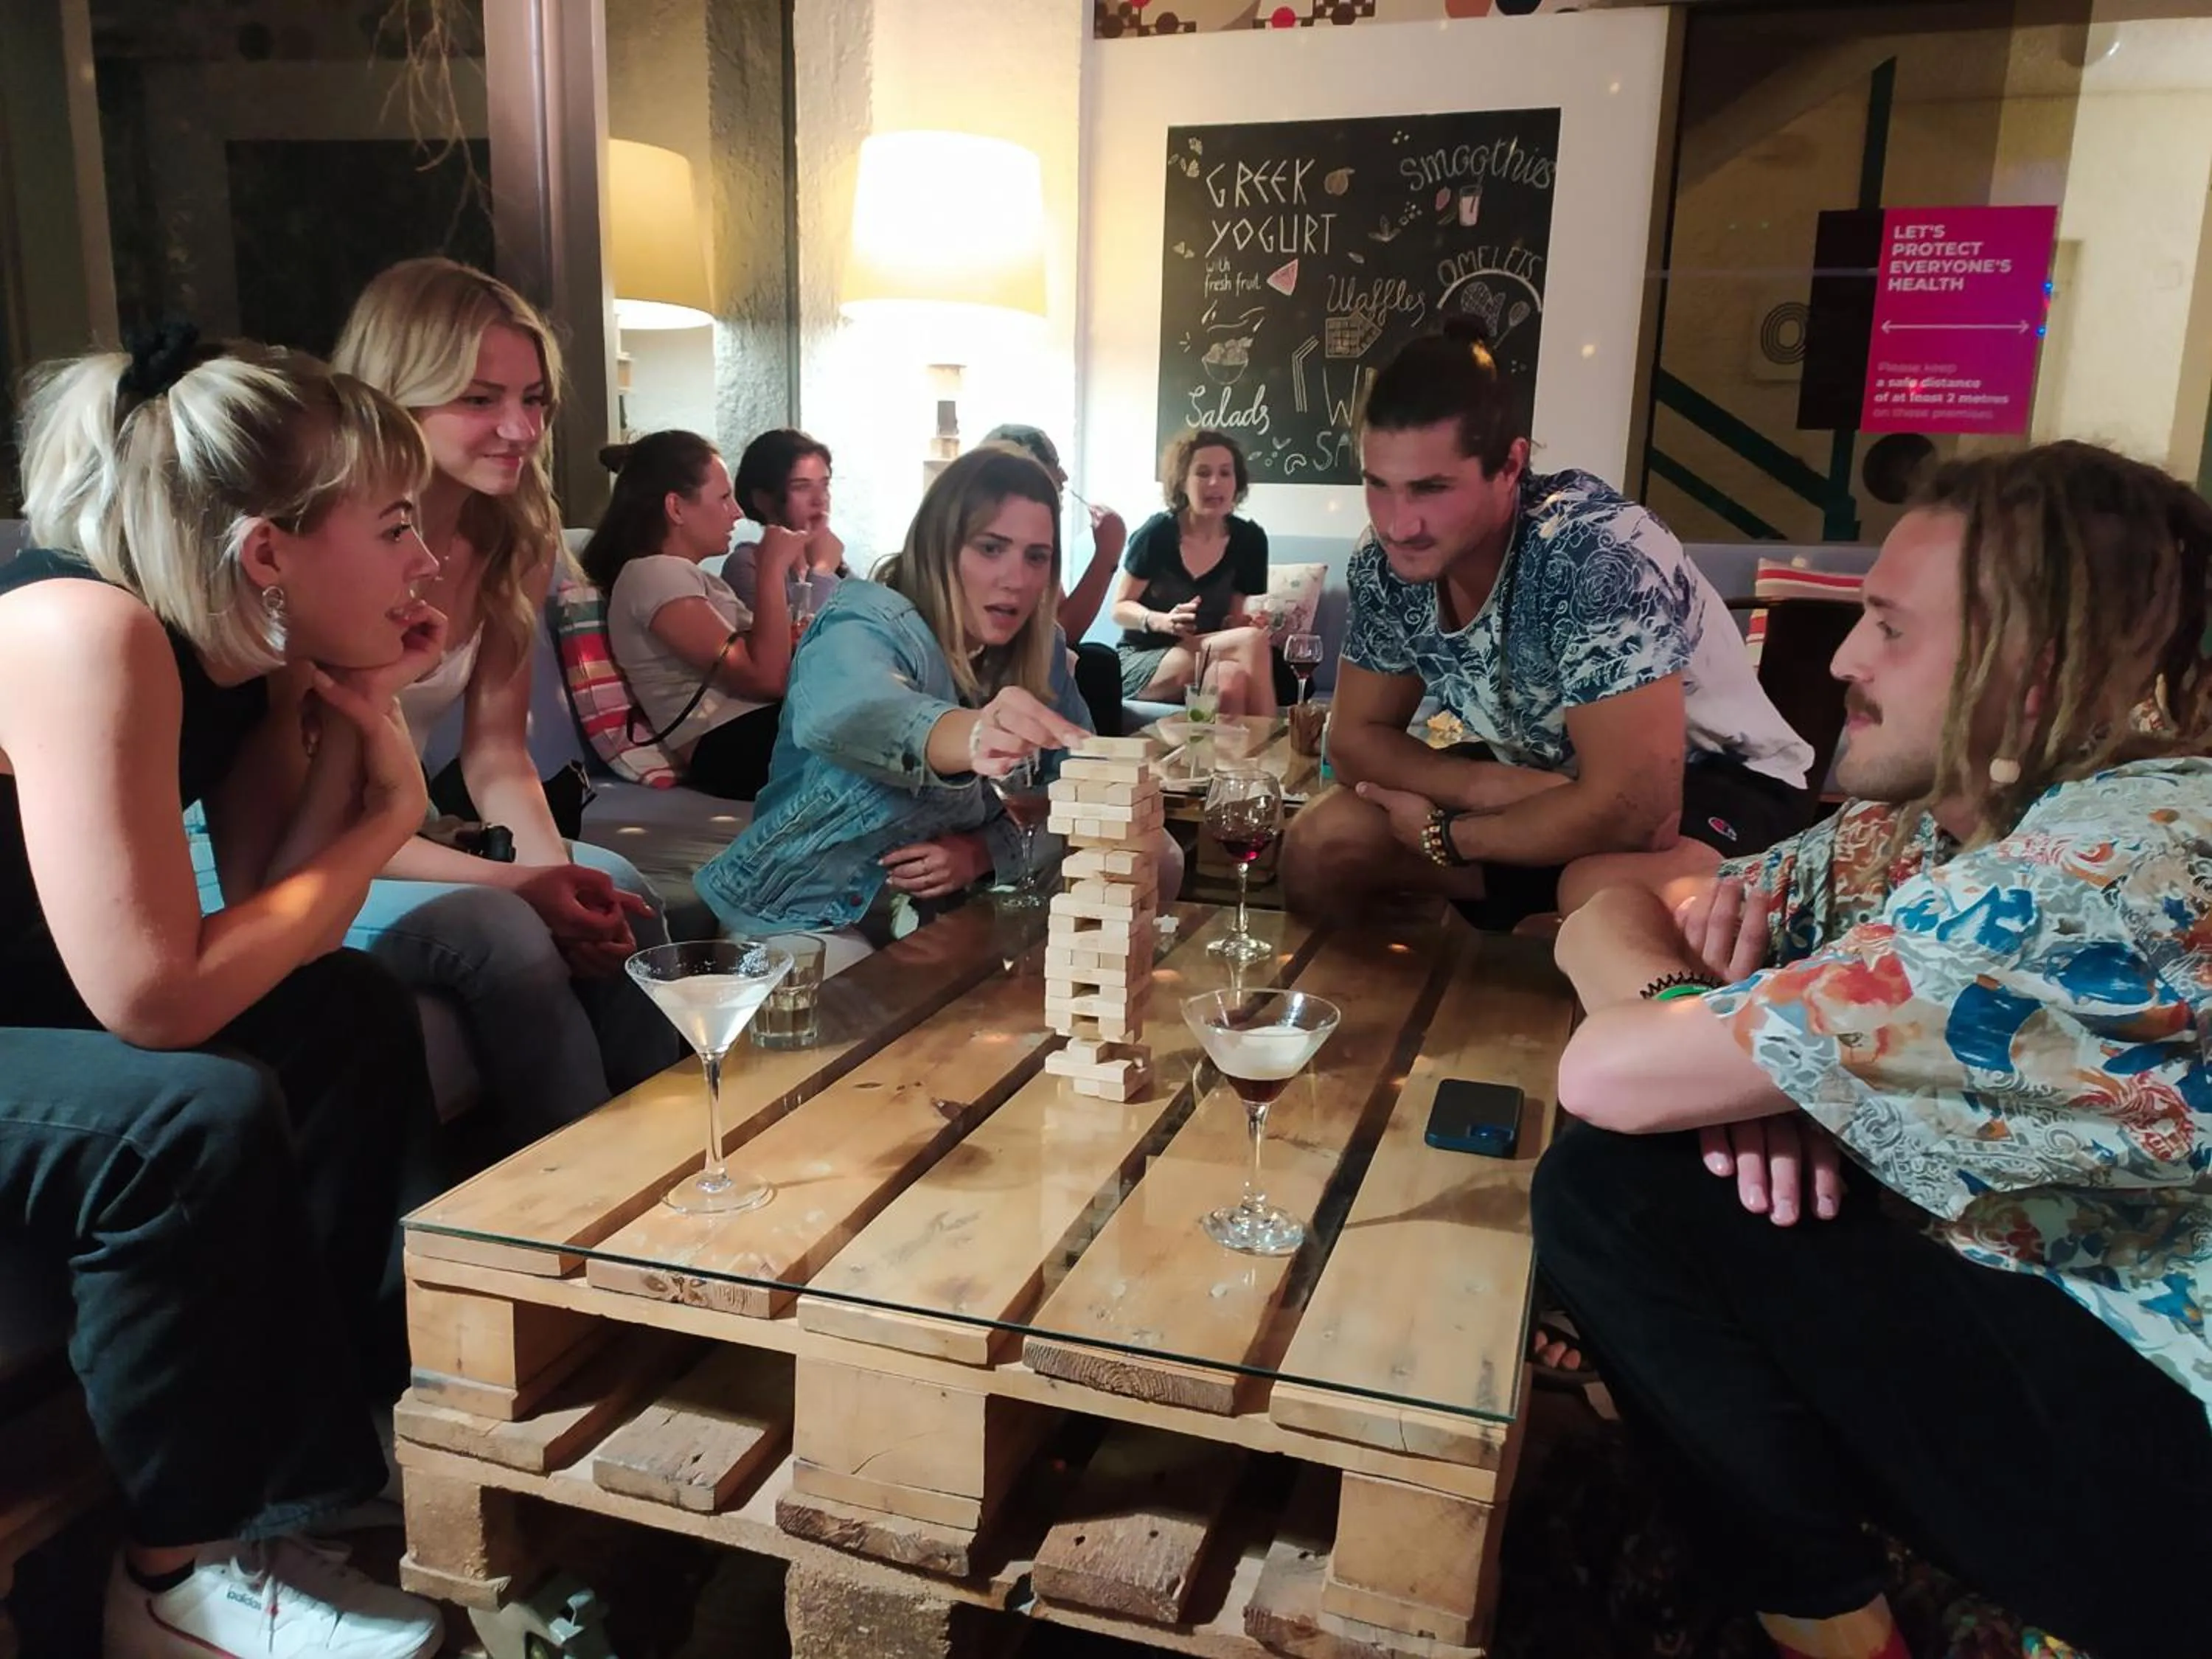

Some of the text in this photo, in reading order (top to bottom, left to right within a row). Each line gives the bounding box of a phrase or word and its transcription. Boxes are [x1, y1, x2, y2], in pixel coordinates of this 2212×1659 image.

[1206, 159, 1315, 209] GREEK
[1204, 213, 1337, 258] YOGURT
[1893, 224, 1946, 240] LET'S
[1891, 241, 1983, 257] PROTECT
[1889, 259, 2012, 274] EVERYONE'S
[1204, 271, 1262, 298] fresh fruit
[1887, 277, 1965, 292] HEALTH
[1327, 274, 1426, 327] Waffles
[1876, 377, 1982, 389] a safe distance
[1874, 392, 1890, 403] of
[1891, 392, 1906, 403] at
[1910, 392, 1943, 403] least
[1946, 393, 1955, 403] 2
[1185, 384, 1270, 435] Salads
